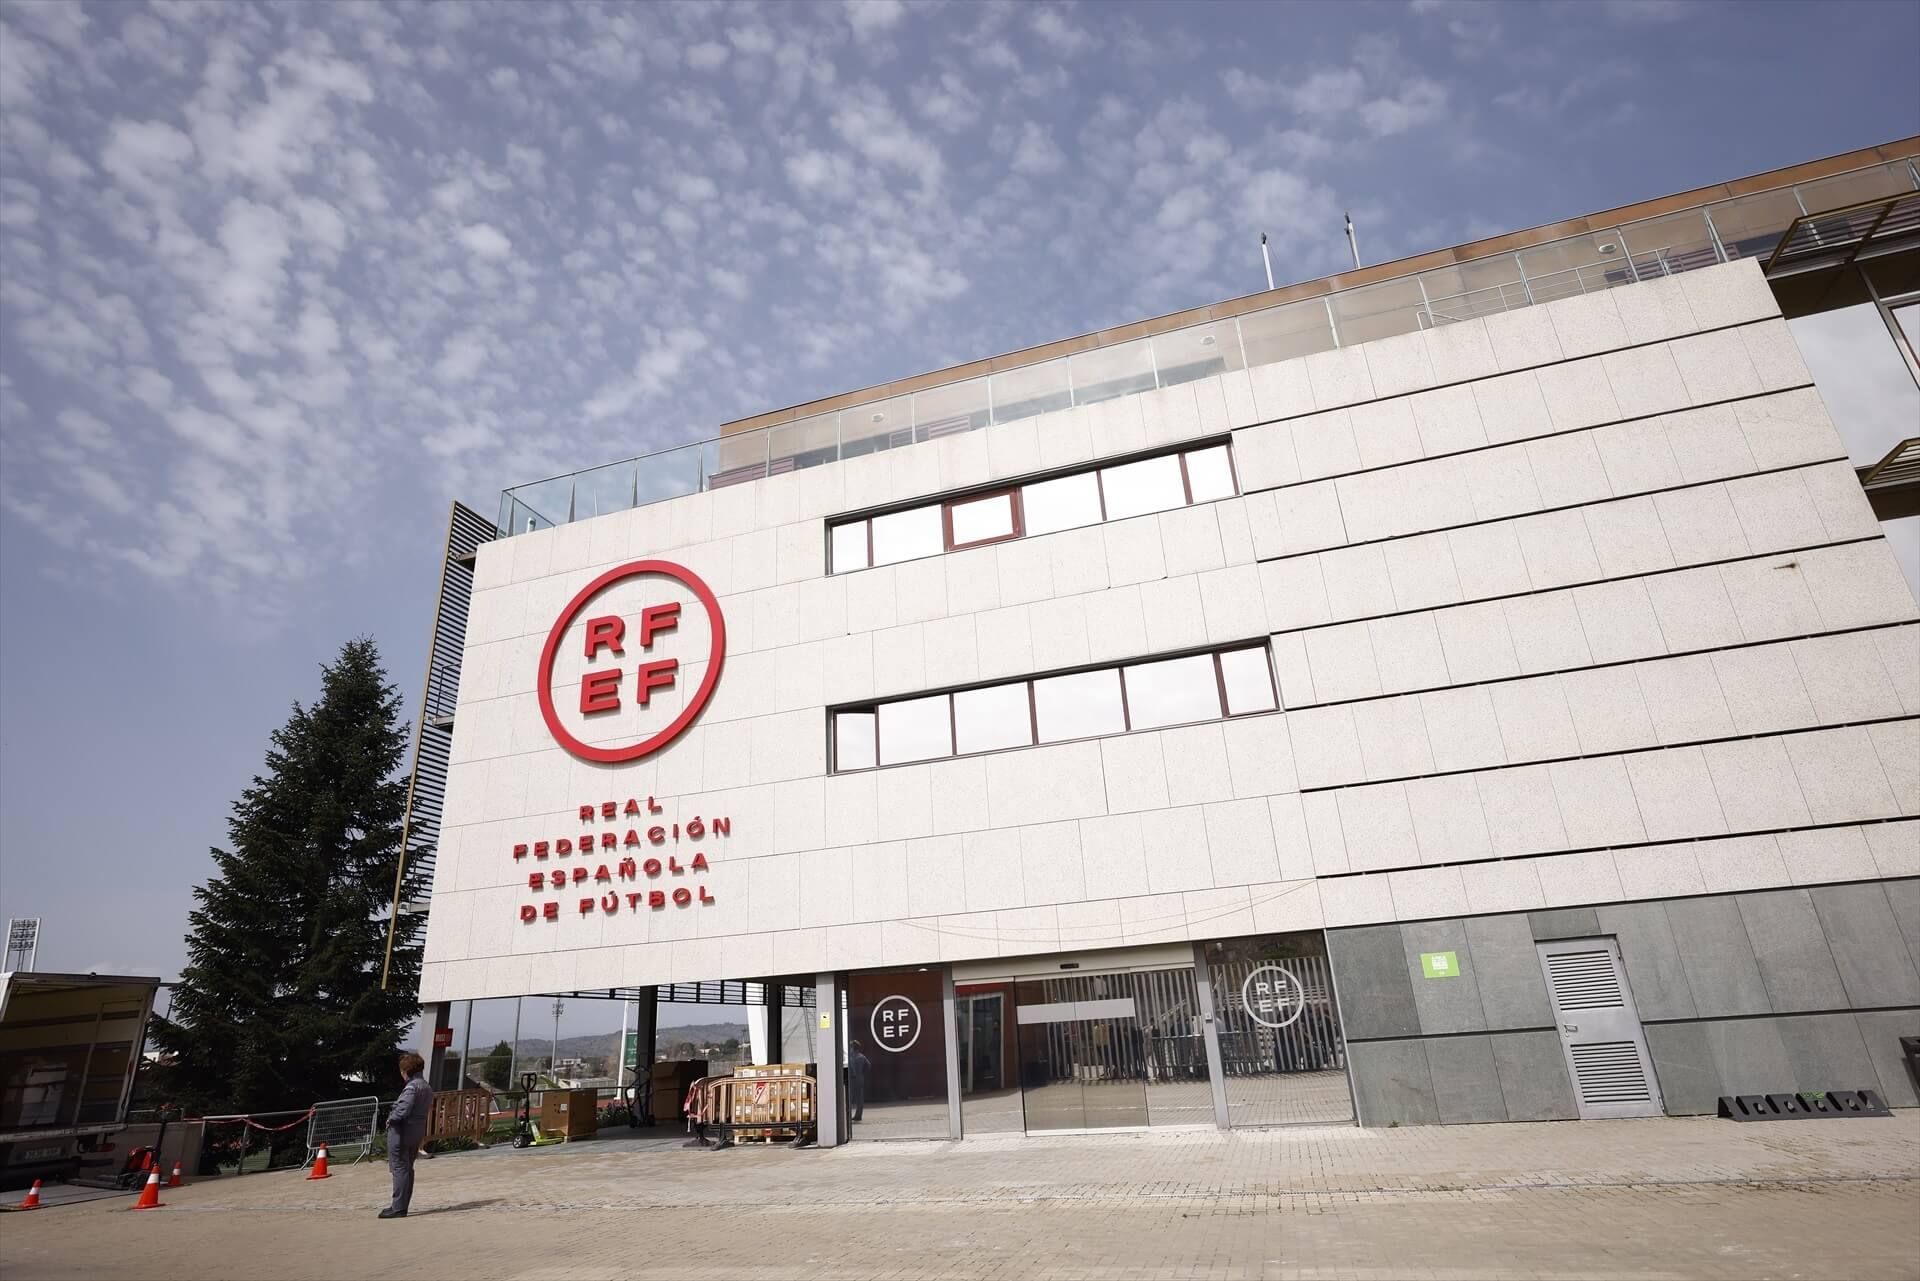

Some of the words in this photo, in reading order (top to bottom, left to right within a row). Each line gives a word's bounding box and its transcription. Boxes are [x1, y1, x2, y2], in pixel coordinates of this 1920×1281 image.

[585, 602, 681, 658] RF
[580, 658, 678, 713] EF
[579, 796, 662, 822] REAL
[513, 816, 731, 861] FEDERACIÓN
[529, 853, 708, 889] ESPAÑOLA
[520, 902, 559, 922] DE
[579, 886, 715, 916] FÚTBOL
[1255, 980, 1287, 995] RF
[883, 1009, 909, 1022] RF
[1259, 998, 1290, 1012] EF
[883, 1025, 909, 1038] EF
